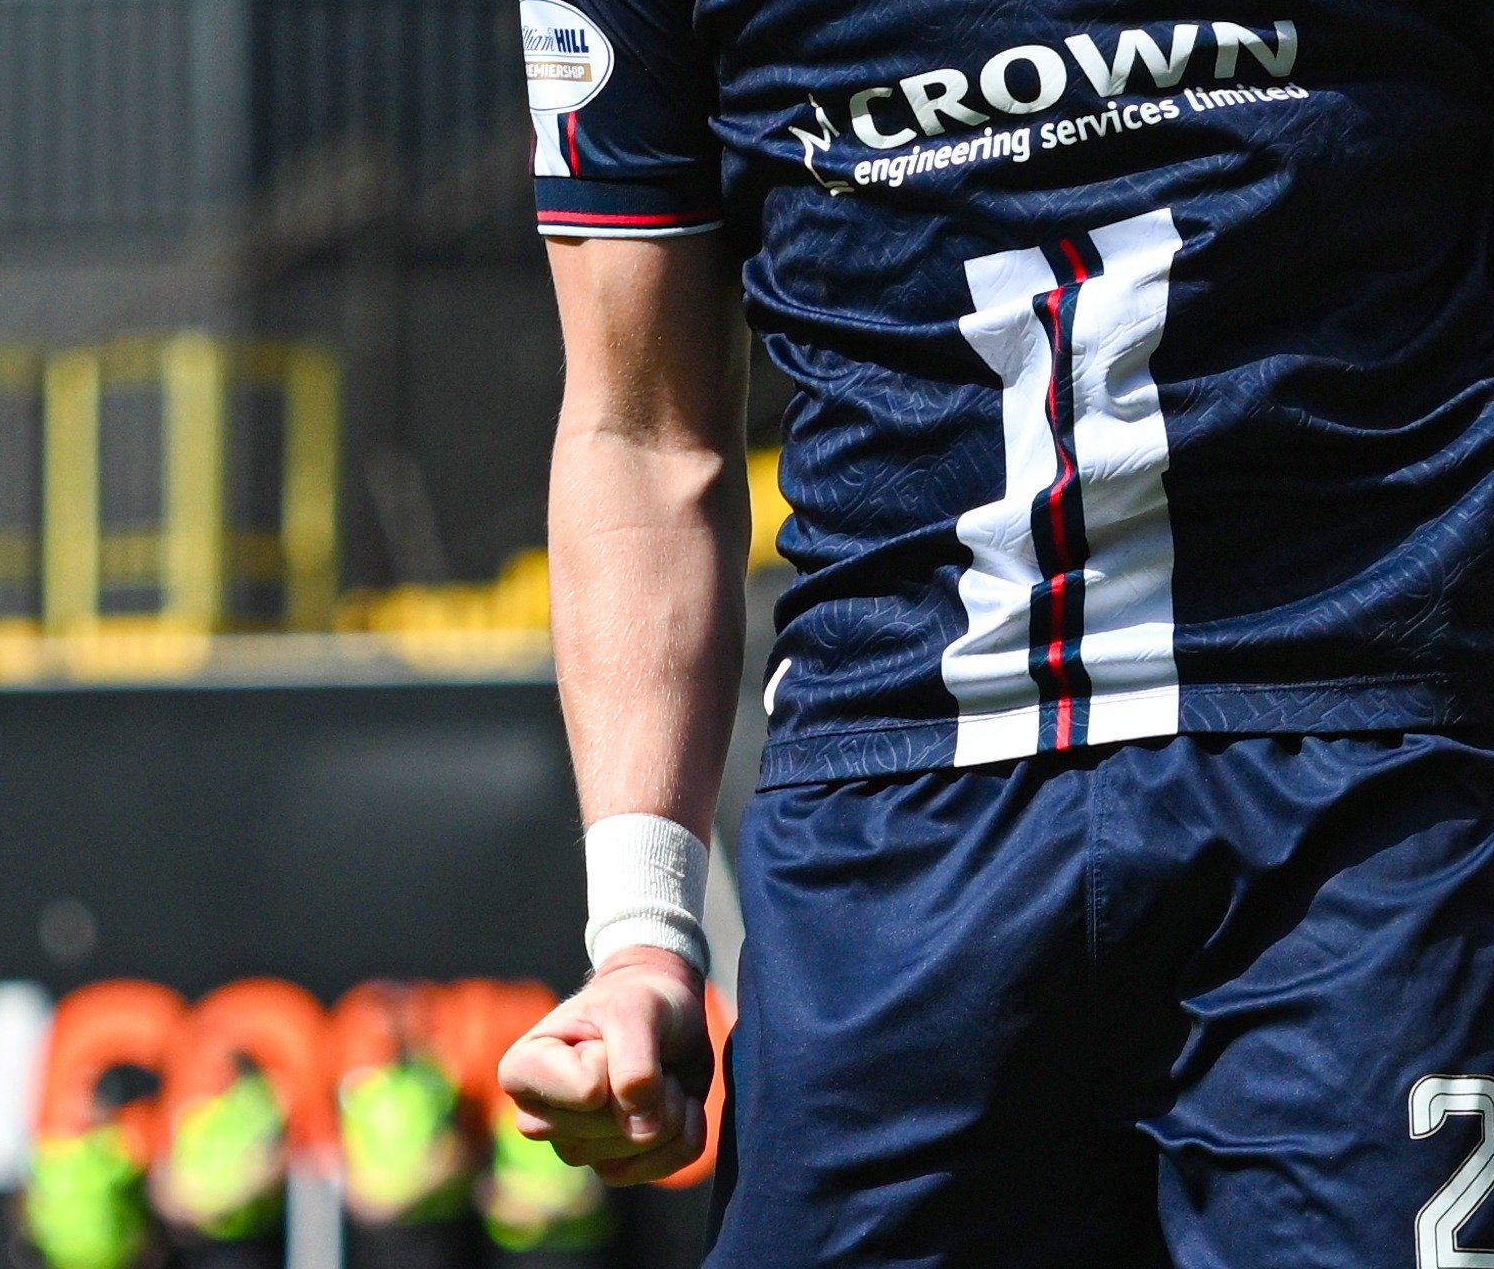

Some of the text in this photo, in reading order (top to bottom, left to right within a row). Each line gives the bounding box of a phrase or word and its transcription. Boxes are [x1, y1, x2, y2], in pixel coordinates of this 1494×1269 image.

[554, 28, 589, 53] HILL
[848, 20, 1299, 150] CROWN
[853, 82, 1310, 188] engineering services limited
